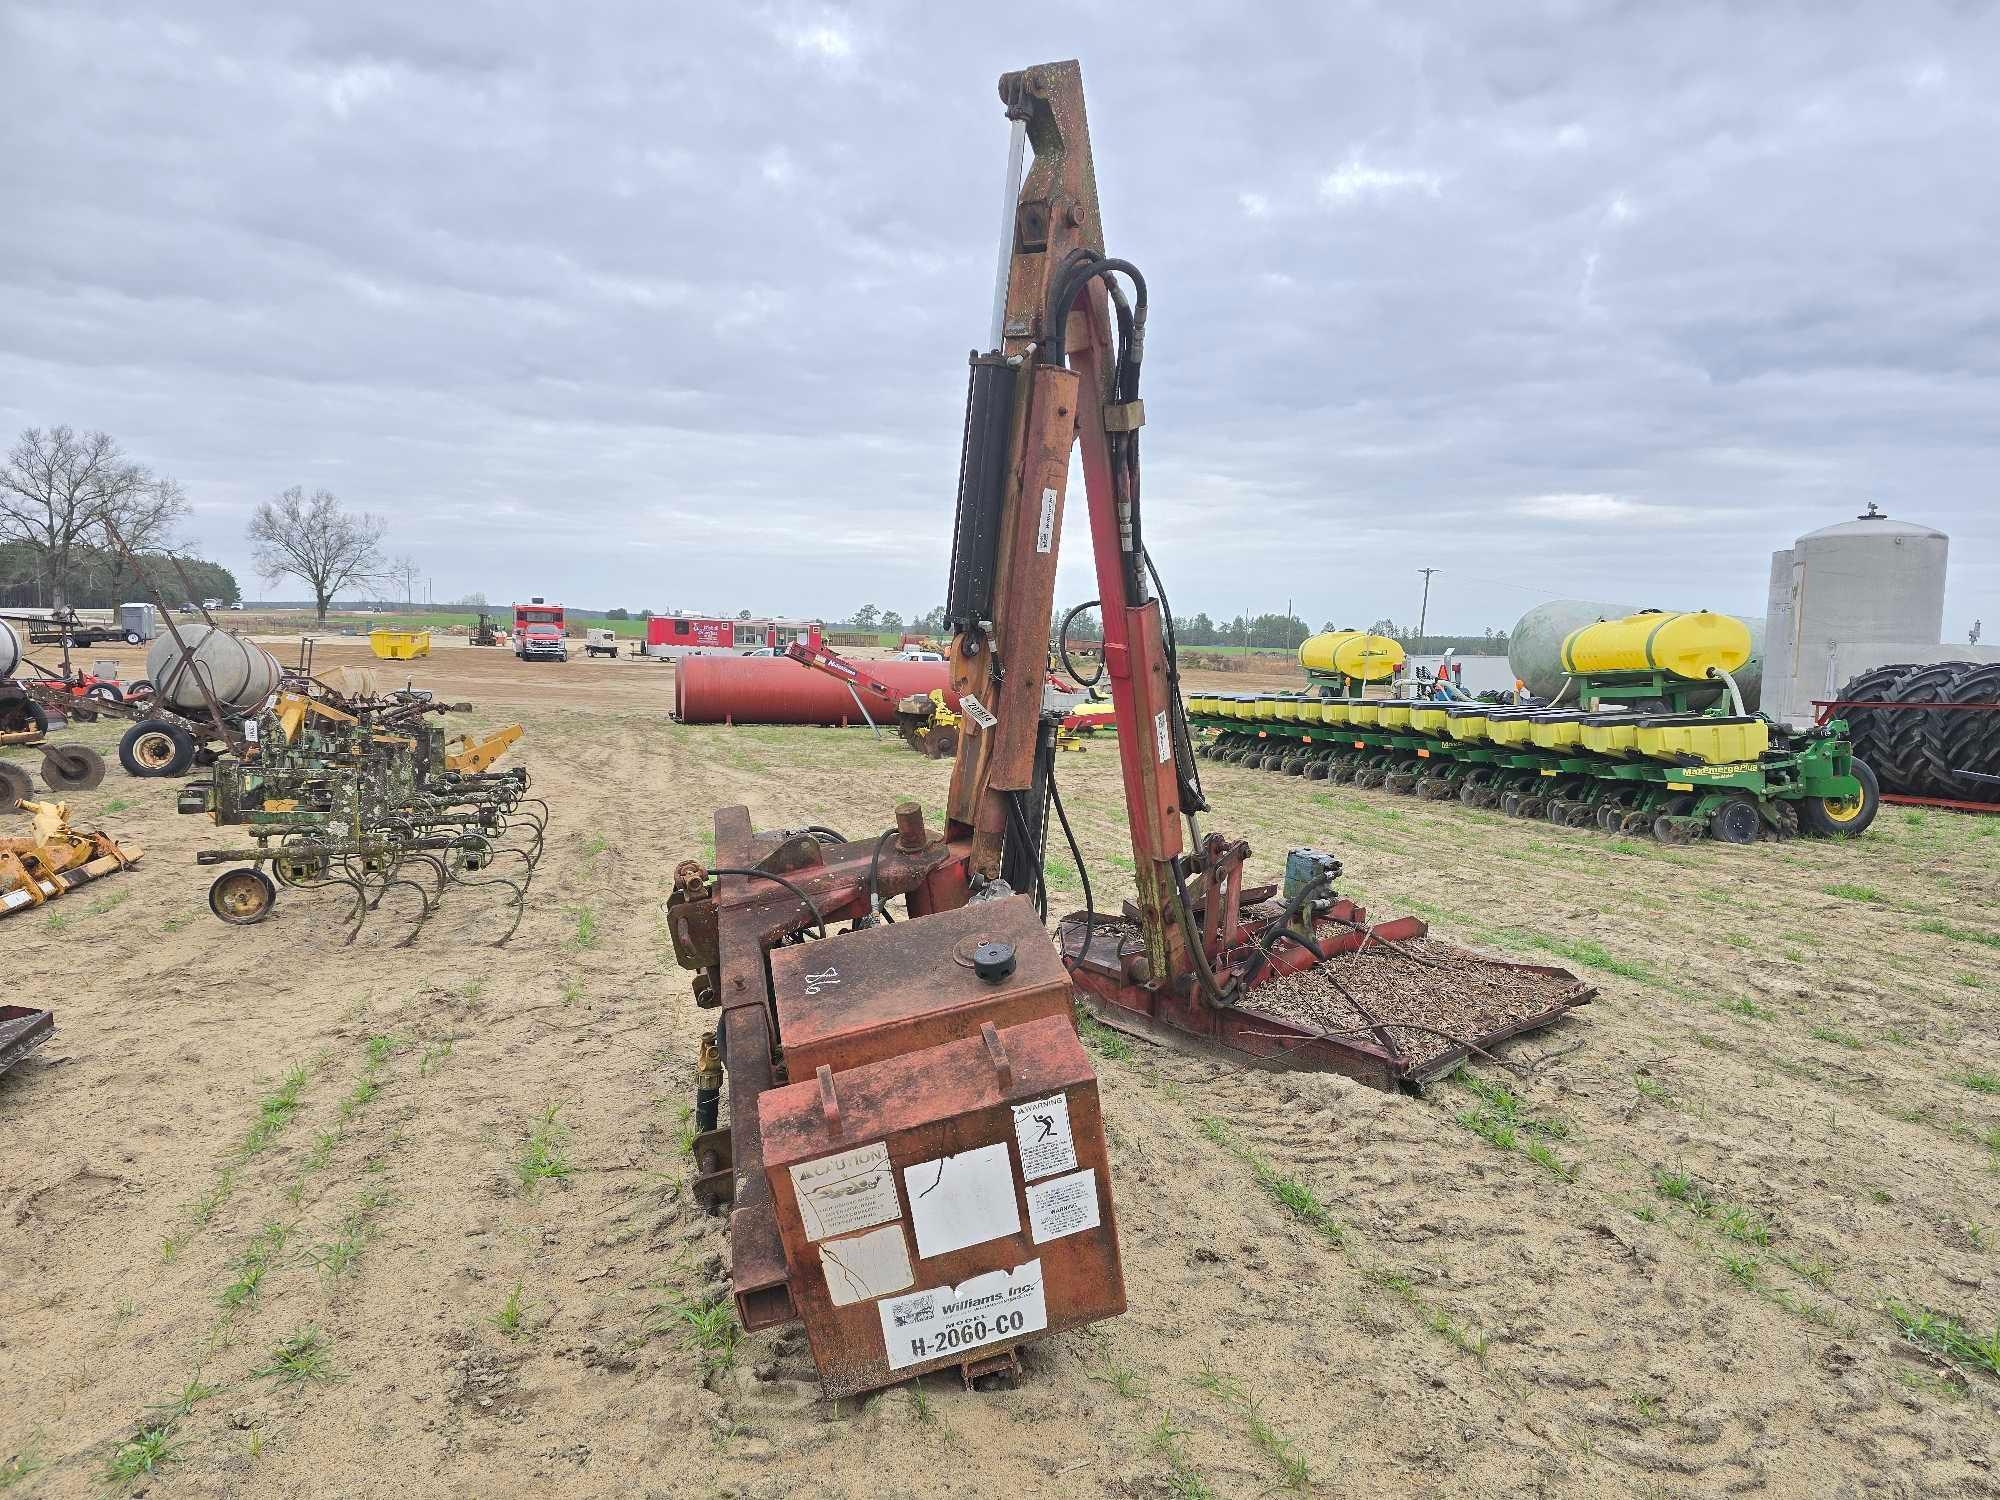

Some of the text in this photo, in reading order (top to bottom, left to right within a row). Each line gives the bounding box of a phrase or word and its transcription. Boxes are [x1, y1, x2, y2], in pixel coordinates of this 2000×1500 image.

[1025, 1097, 1063, 1113] WARNING
[814, 1149, 882, 1176] CAUTION
[1051, 1202, 1078, 1215] WARNING
[942, 1291, 1003, 1315] Williams
[1008, 1284, 1035, 1297] Inc.
[945, 1314, 988, 1329] MODEL
